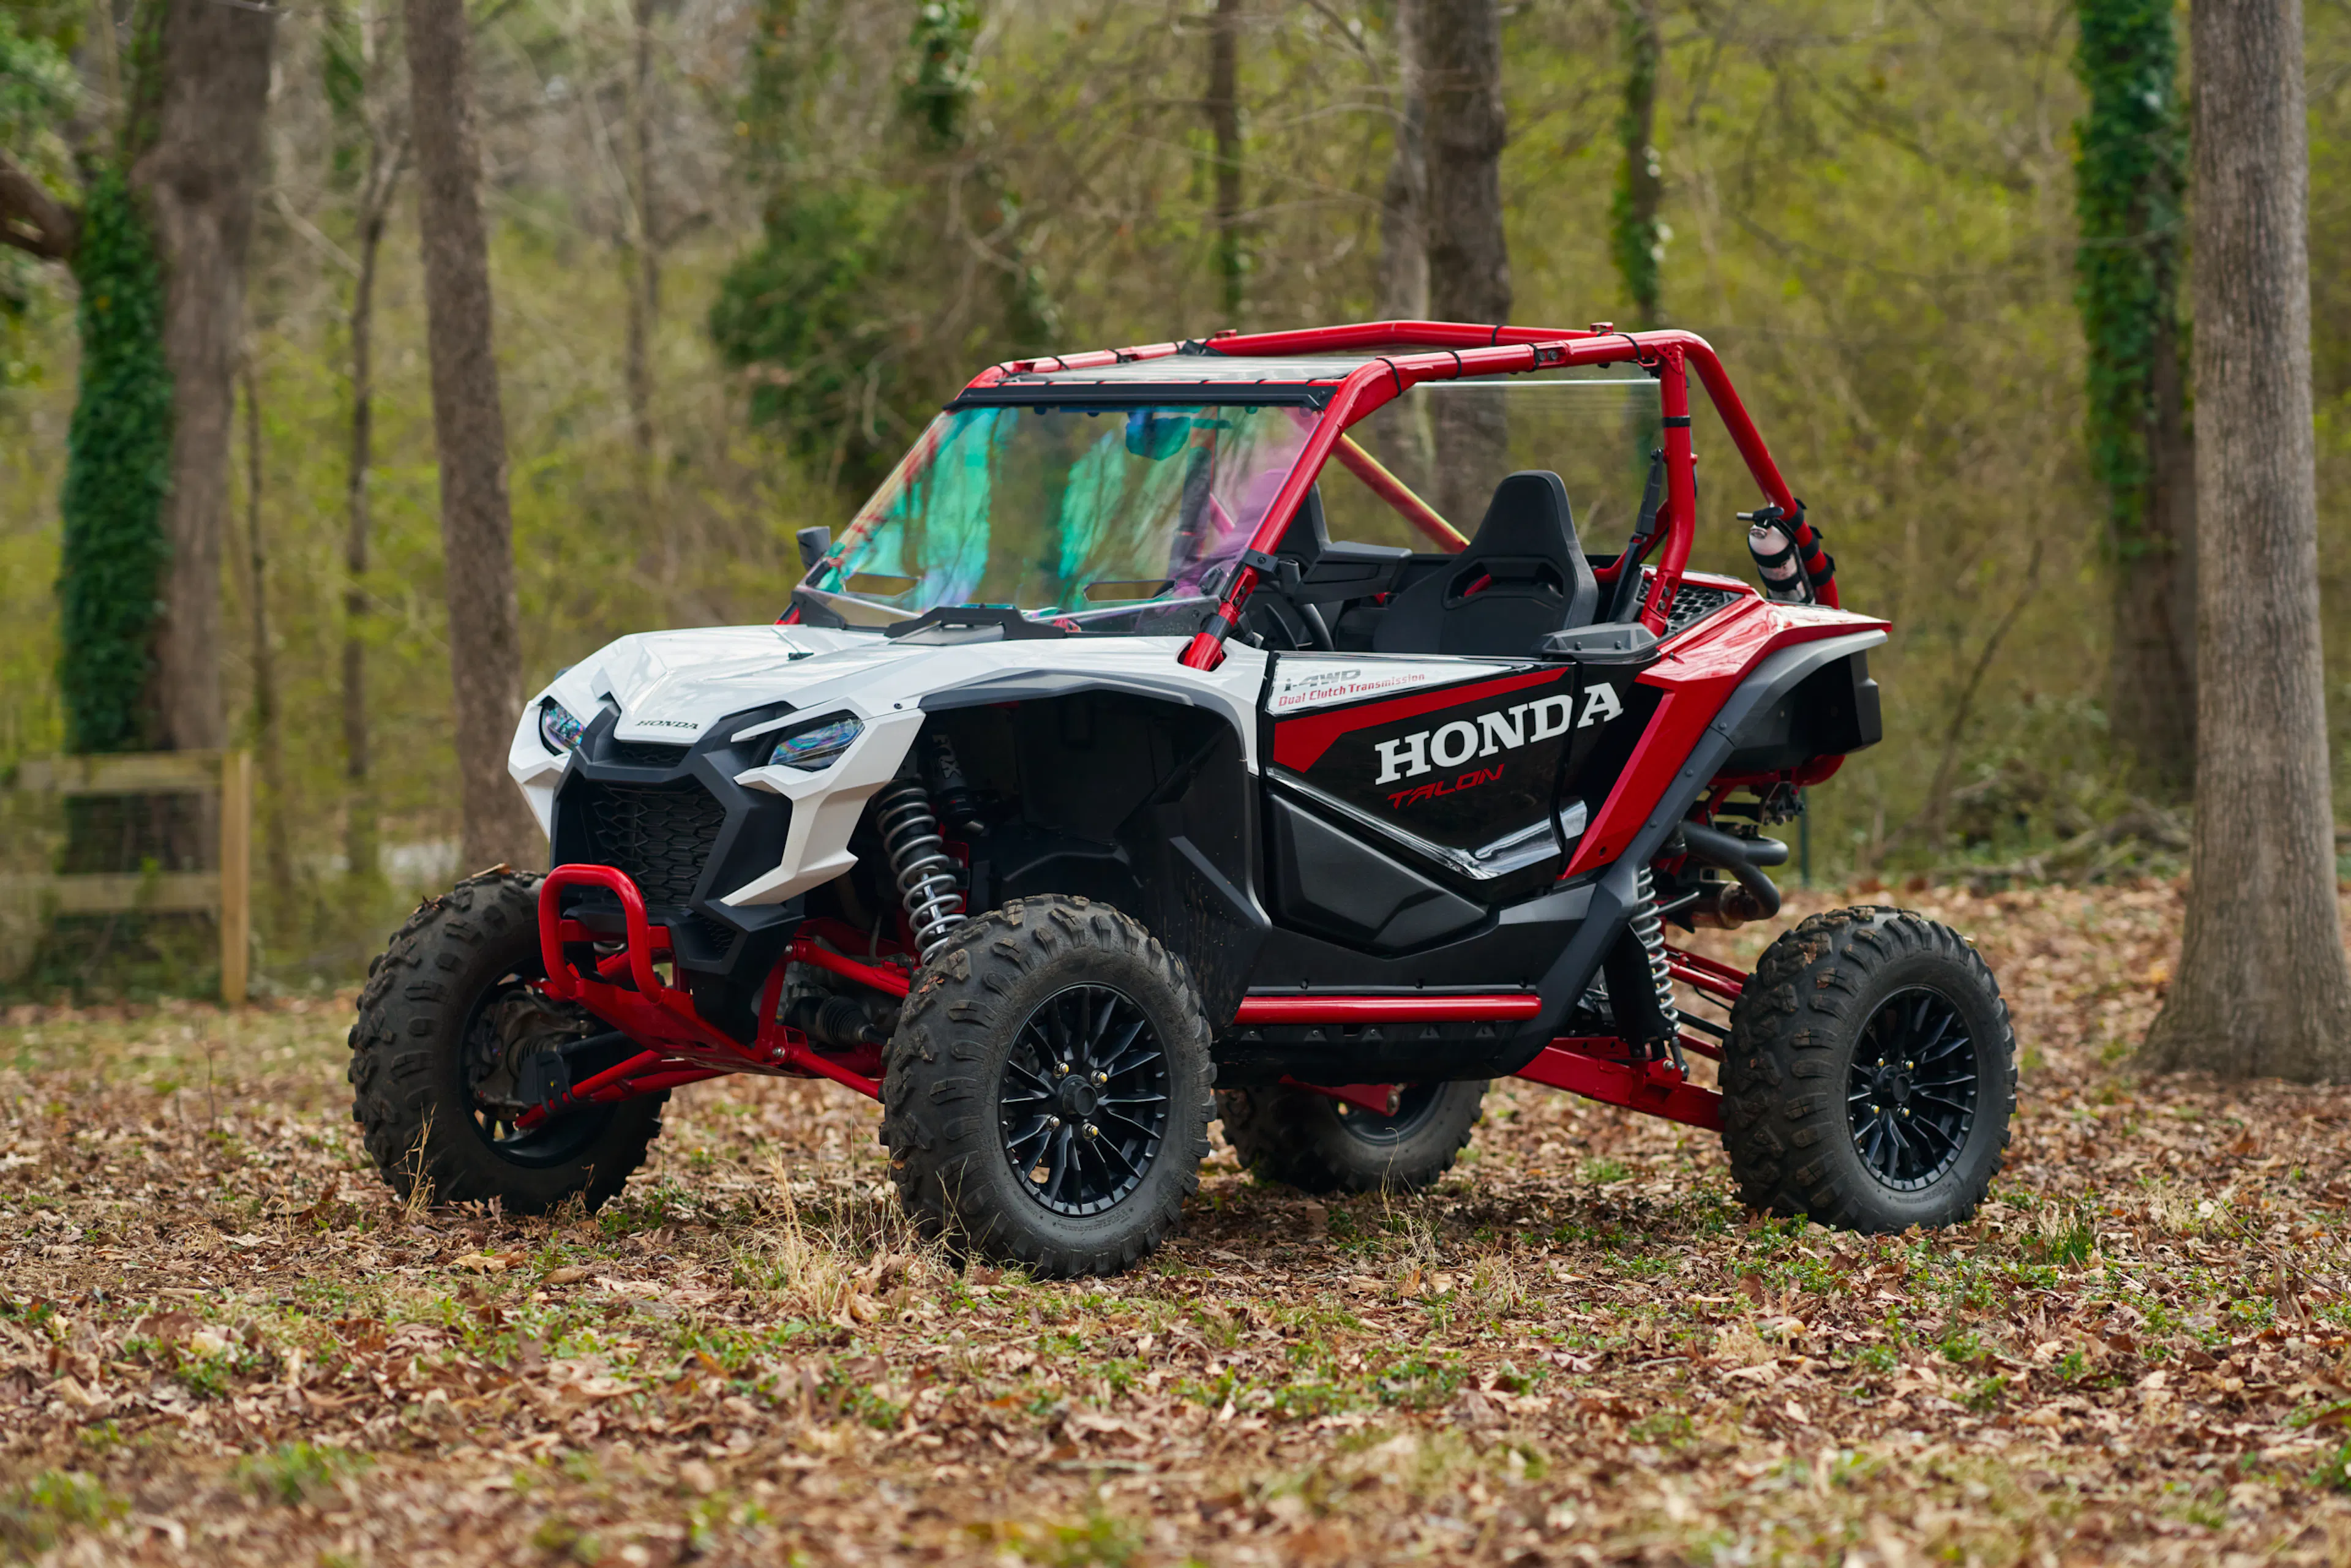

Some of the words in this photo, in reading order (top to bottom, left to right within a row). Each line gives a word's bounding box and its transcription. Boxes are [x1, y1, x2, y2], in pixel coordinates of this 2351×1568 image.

[1278, 692, 1305, 707] Dual
[1310, 686, 1346, 700] Clutch
[1349, 673, 1425, 693] Transmission
[634, 720, 699, 730] HONDA
[1374, 682, 1624, 785] HONDA
[1387, 763, 1505, 809] TALON
